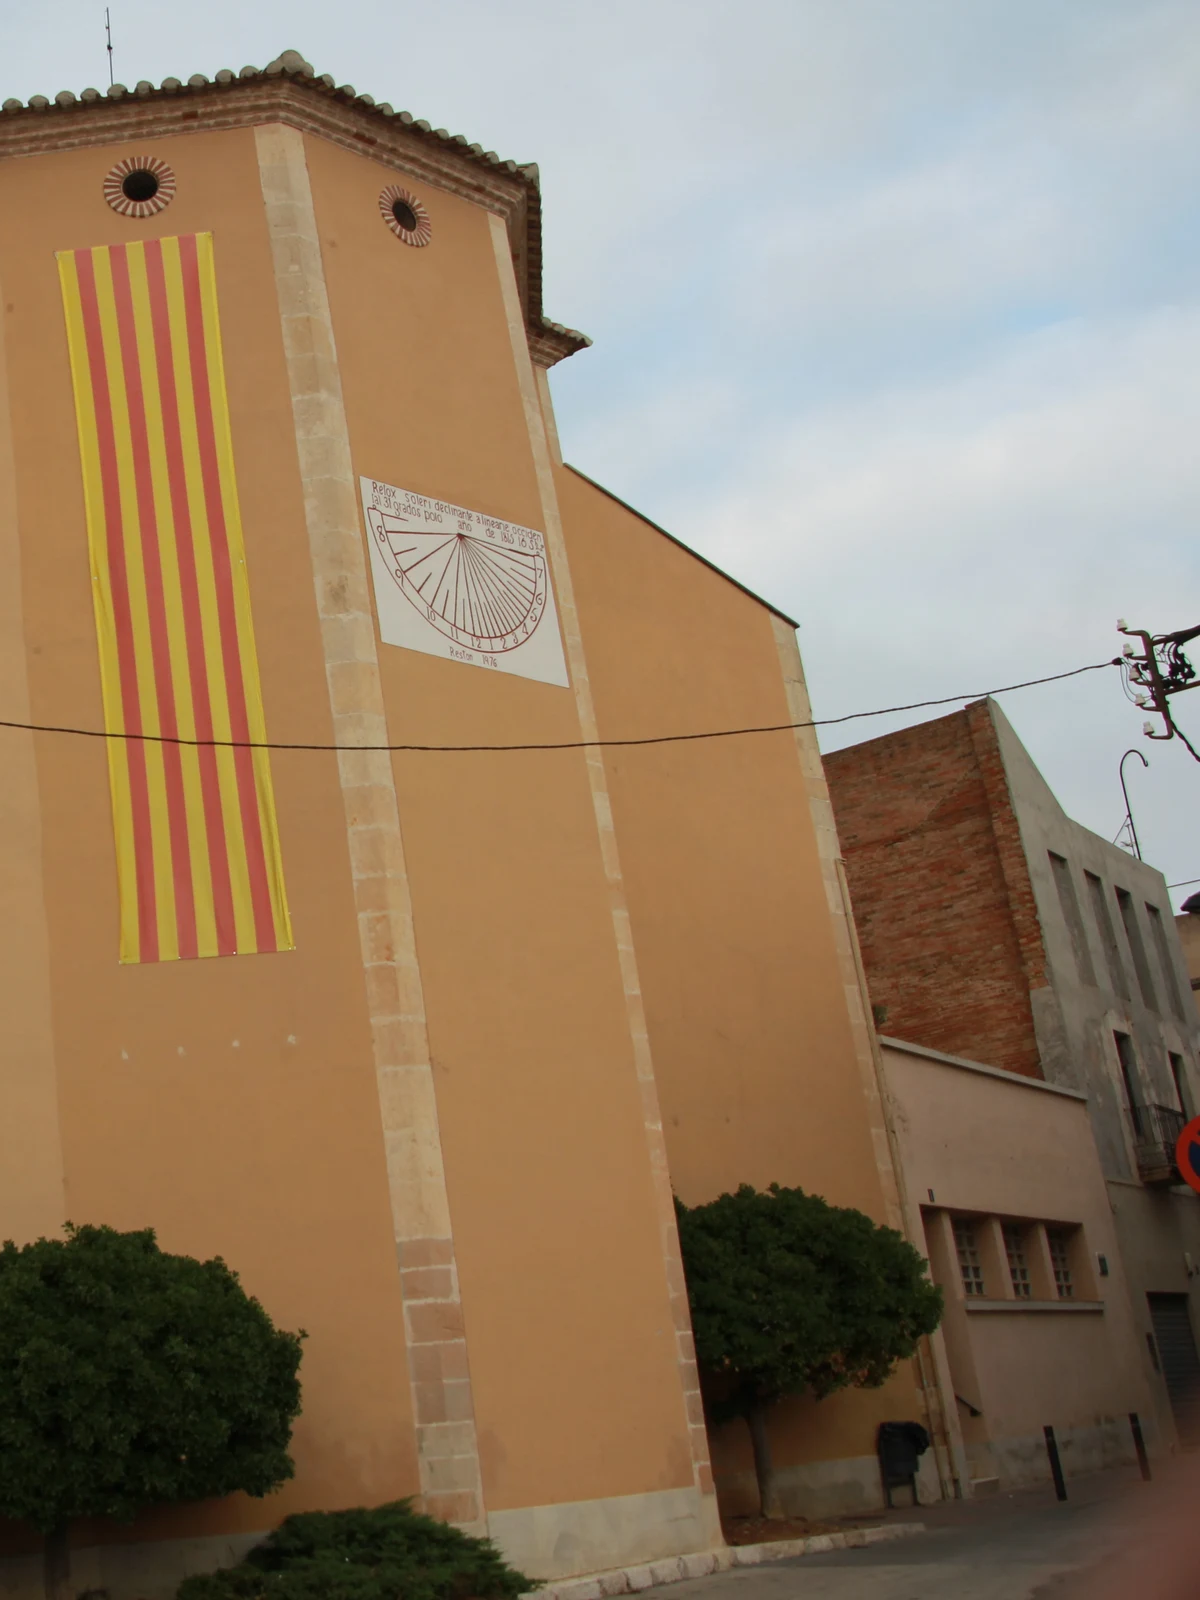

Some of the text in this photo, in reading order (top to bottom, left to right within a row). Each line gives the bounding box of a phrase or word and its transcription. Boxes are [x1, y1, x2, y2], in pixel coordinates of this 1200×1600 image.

[372, 481, 396, 499] Relox
[393, 500, 421, 517] grados
[423, 510, 443, 523] polo
[485, 528, 495, 539] de
[376, 525, 386, 543] 8
[394, 568, 405, 588] 9
[536, 567, 544, 579] 7
[535, 592, 543, 606] 6
[426, 606, 436, 622] 10
[529, 607, 538, 622] 5
[450, 626, 459, 640] 11
[521, 622, 529, 636] 4
[471, 636, 482, 649] 12
[499, 636, 508, 650] 2
[511, 631, 519, 644] 3
[489, 639, 494, 651] 1
[482, 654, 498, 668] 1976
